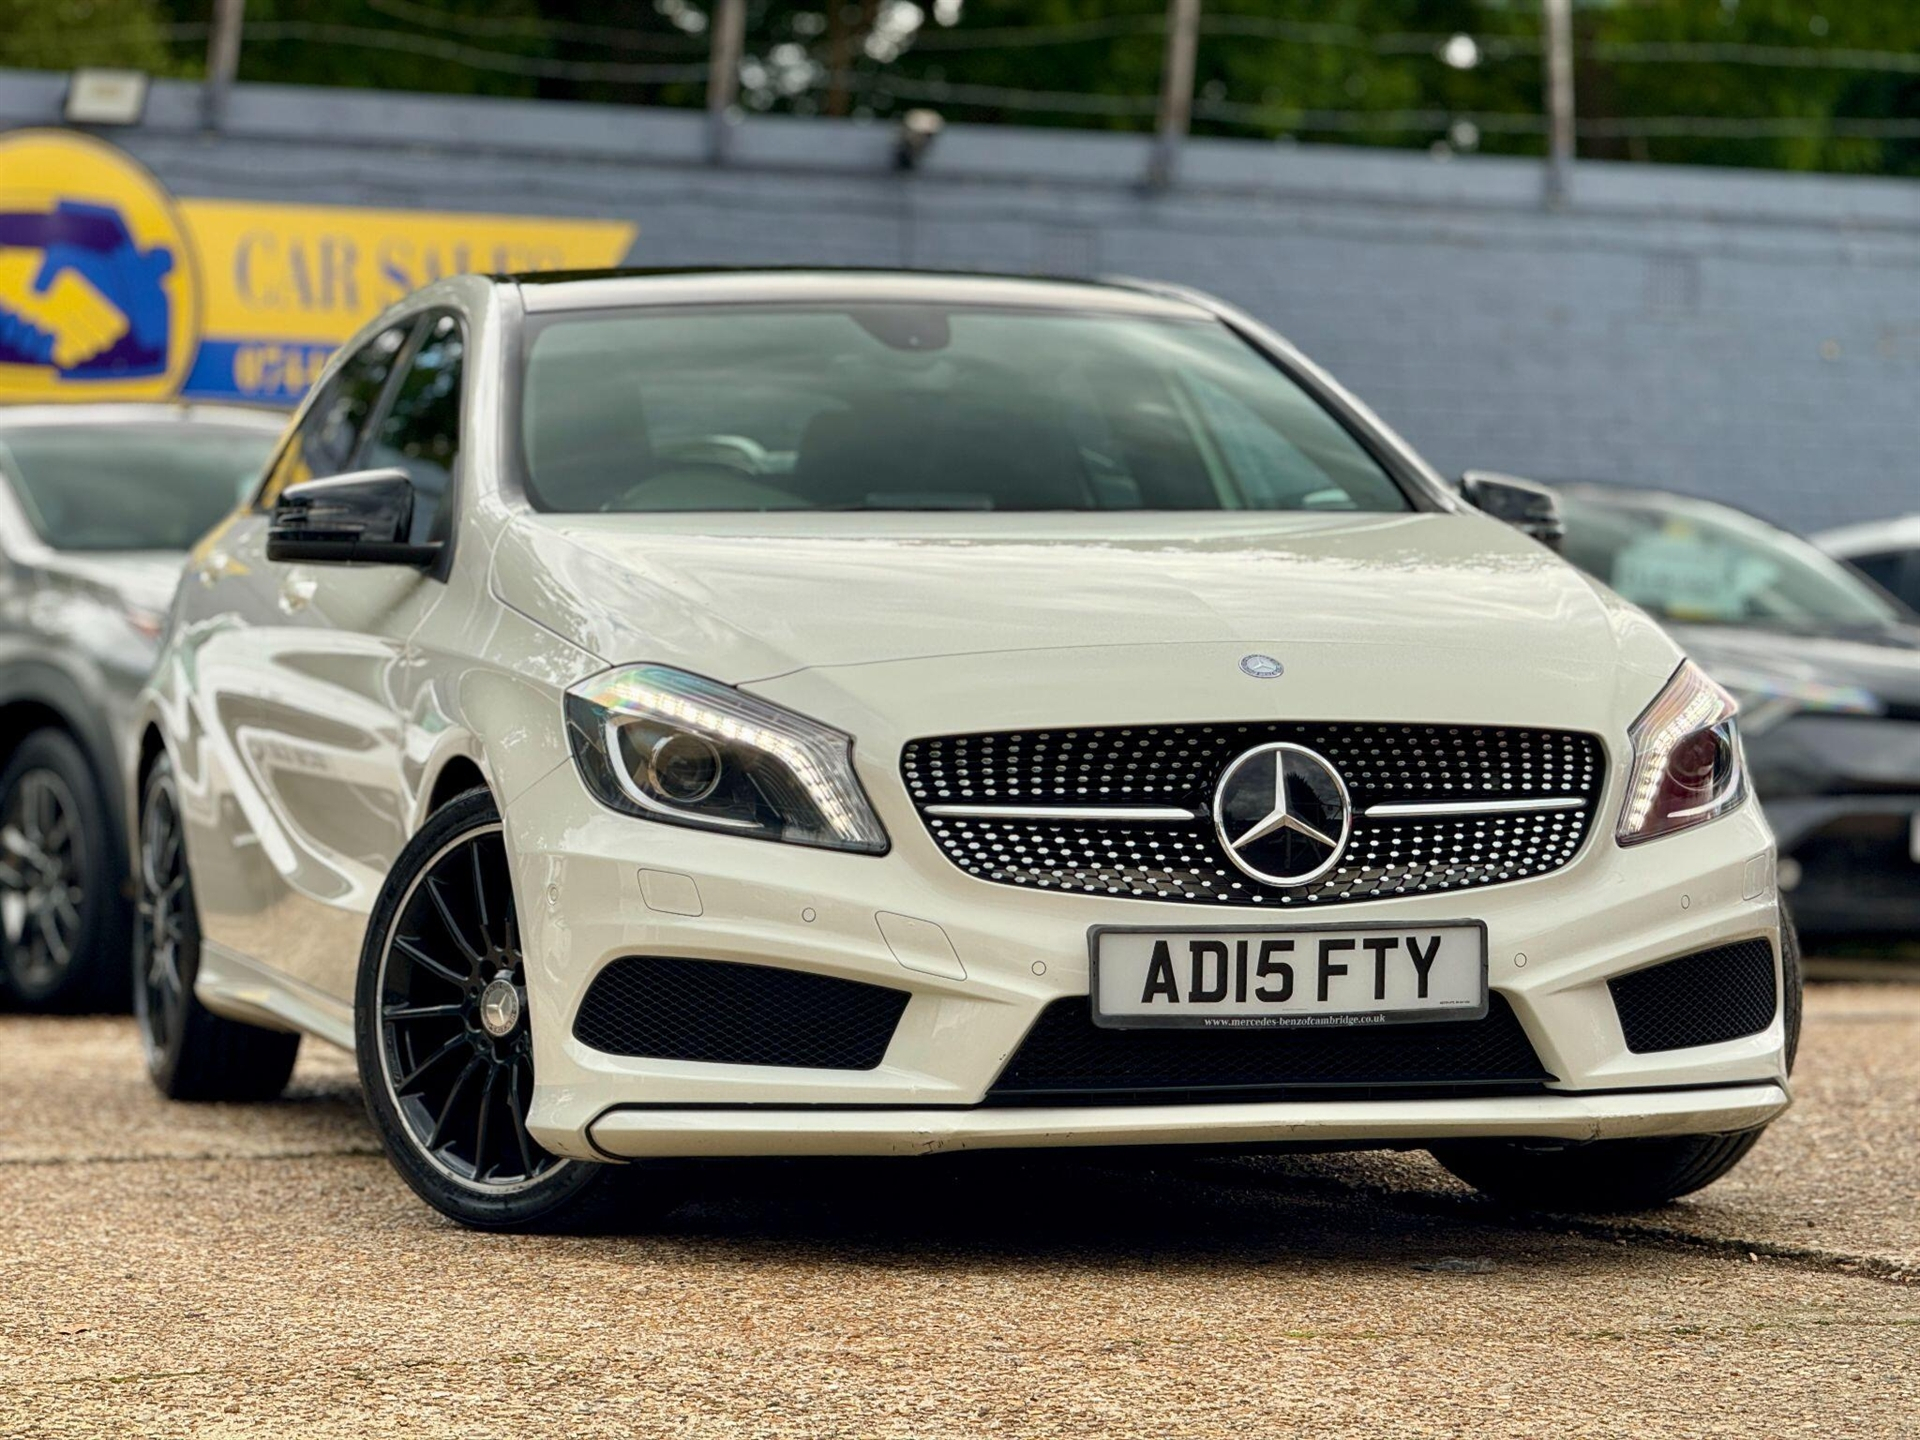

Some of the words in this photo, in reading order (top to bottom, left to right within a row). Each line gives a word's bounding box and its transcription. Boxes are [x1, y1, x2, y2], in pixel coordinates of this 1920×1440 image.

[234, 230, 359, 313] CAR
[1141, 939, 1295, 1003] AD15
[1317, 935, 1442, 1002] FTY
[1204, 1013, 1386, 1026] www.mercedes-benzofcambridge.co.uk
